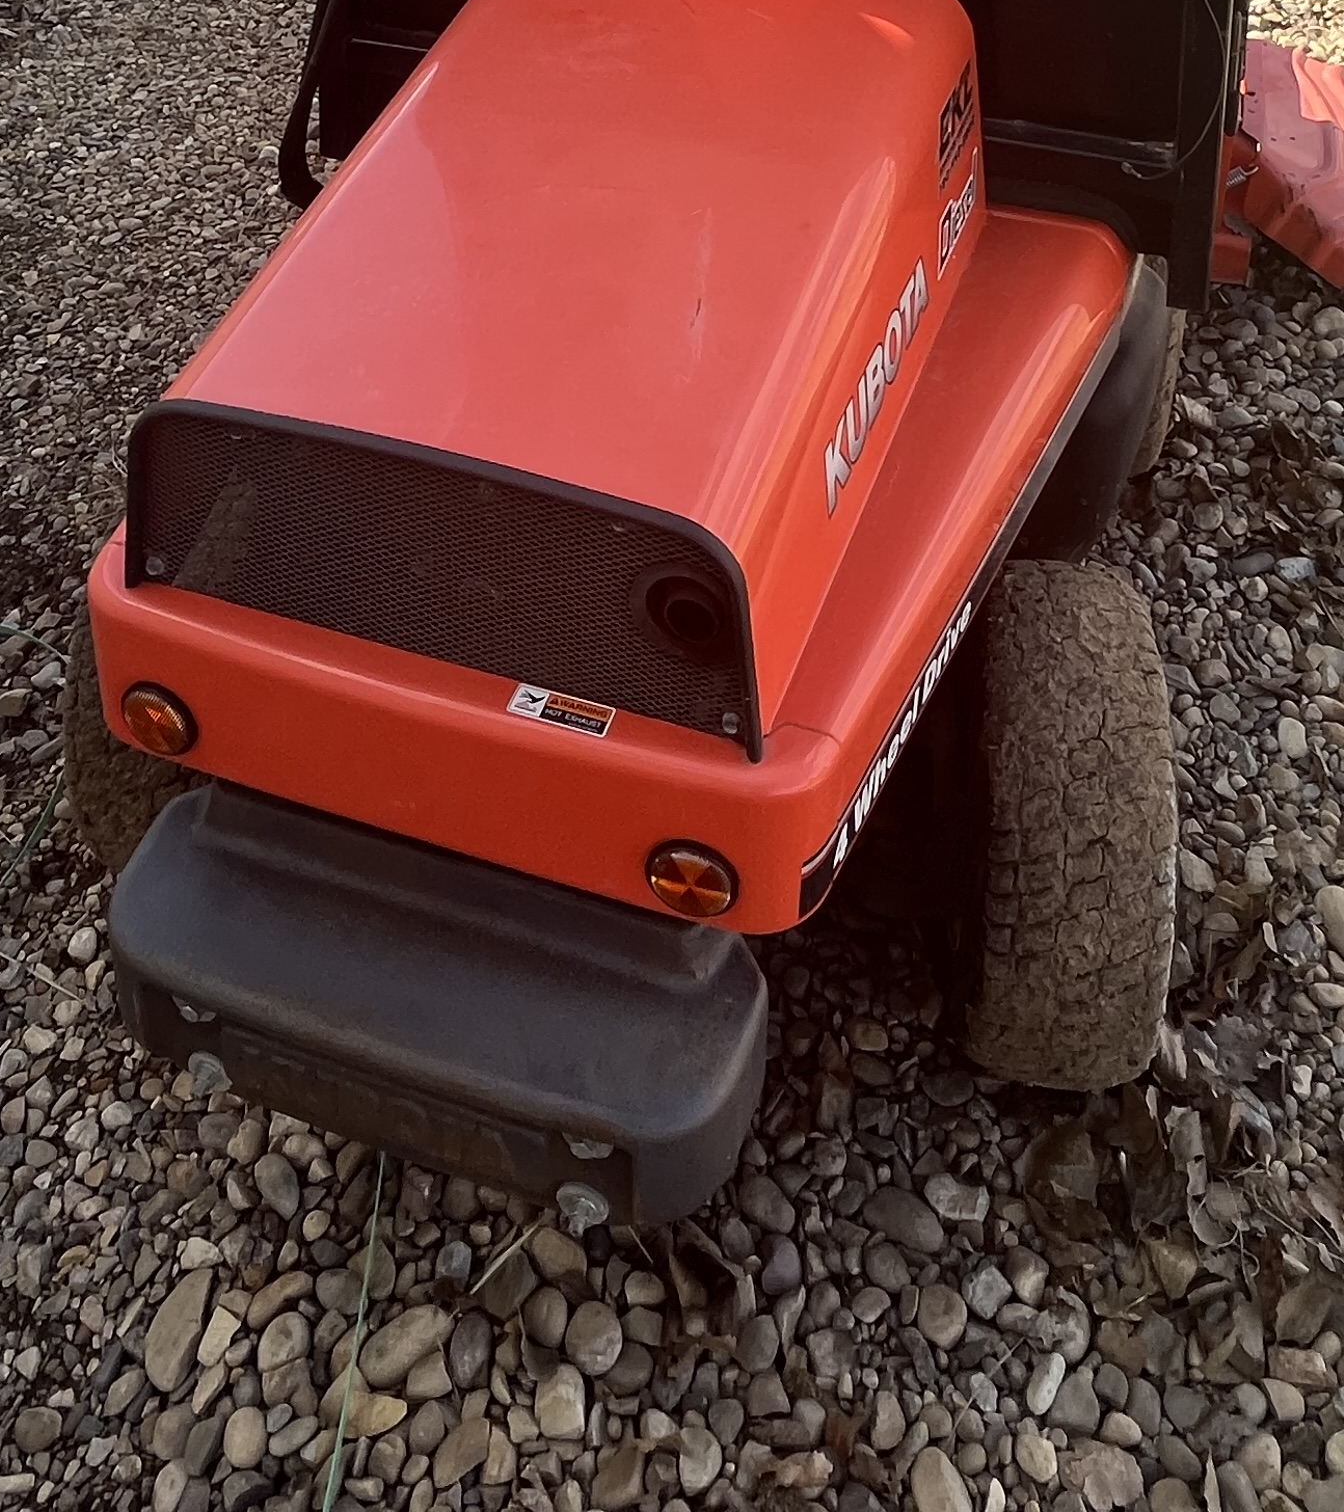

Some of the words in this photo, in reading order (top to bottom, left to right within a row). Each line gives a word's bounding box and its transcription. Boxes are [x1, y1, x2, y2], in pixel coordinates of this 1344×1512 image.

[824, 255, 930, 520] KUBOTA
[544, 707, 562, 718] HOT
[564, 712, 602, 729] EXHAUST
[559, 697, 608, 719] WARNING
[833, 822, 849, 869] 4
[854, 686, 921, 832] Wheel
[920, 601, 972, 705] Drive
